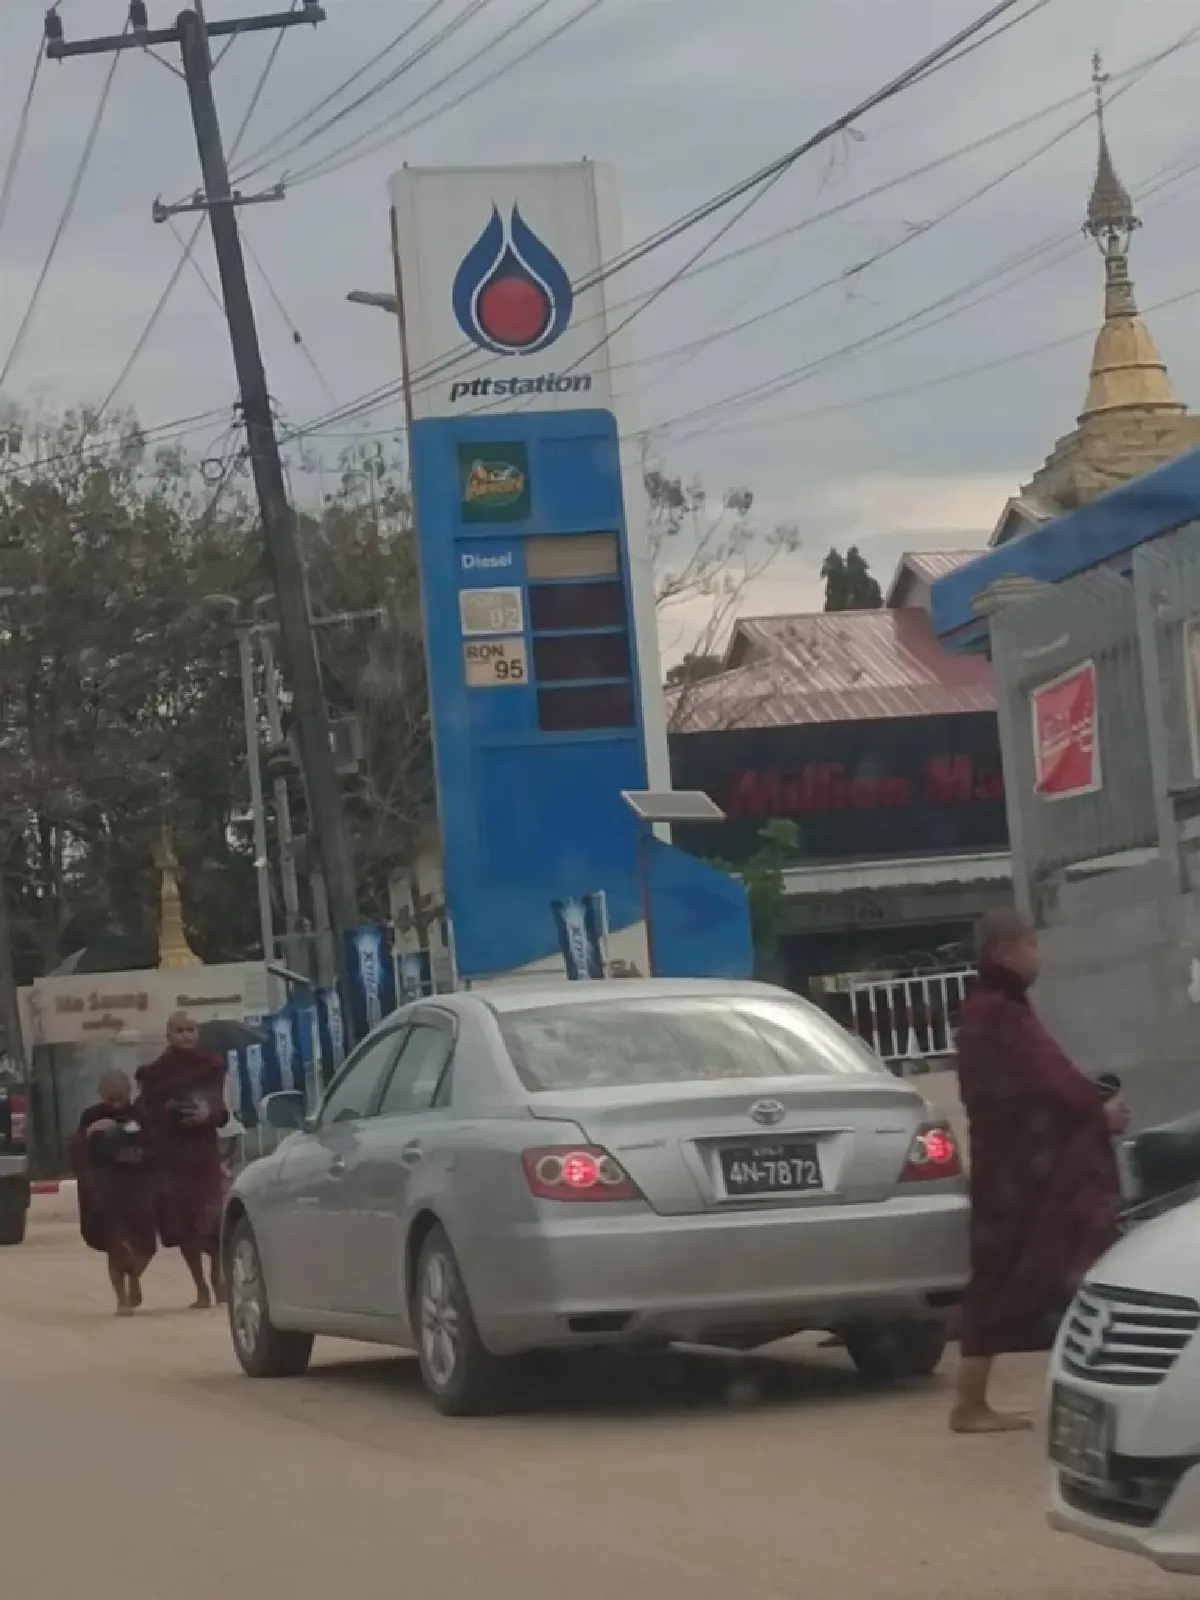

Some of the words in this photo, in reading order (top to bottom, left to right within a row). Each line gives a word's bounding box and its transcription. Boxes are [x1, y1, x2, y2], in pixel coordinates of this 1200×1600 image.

[461, 551, 512, 569] Diesel
[466, 643, 505, 658] RON
[494, 658, 523, 680] 95
[729, 1158, 820, 1185] 4N-7872
